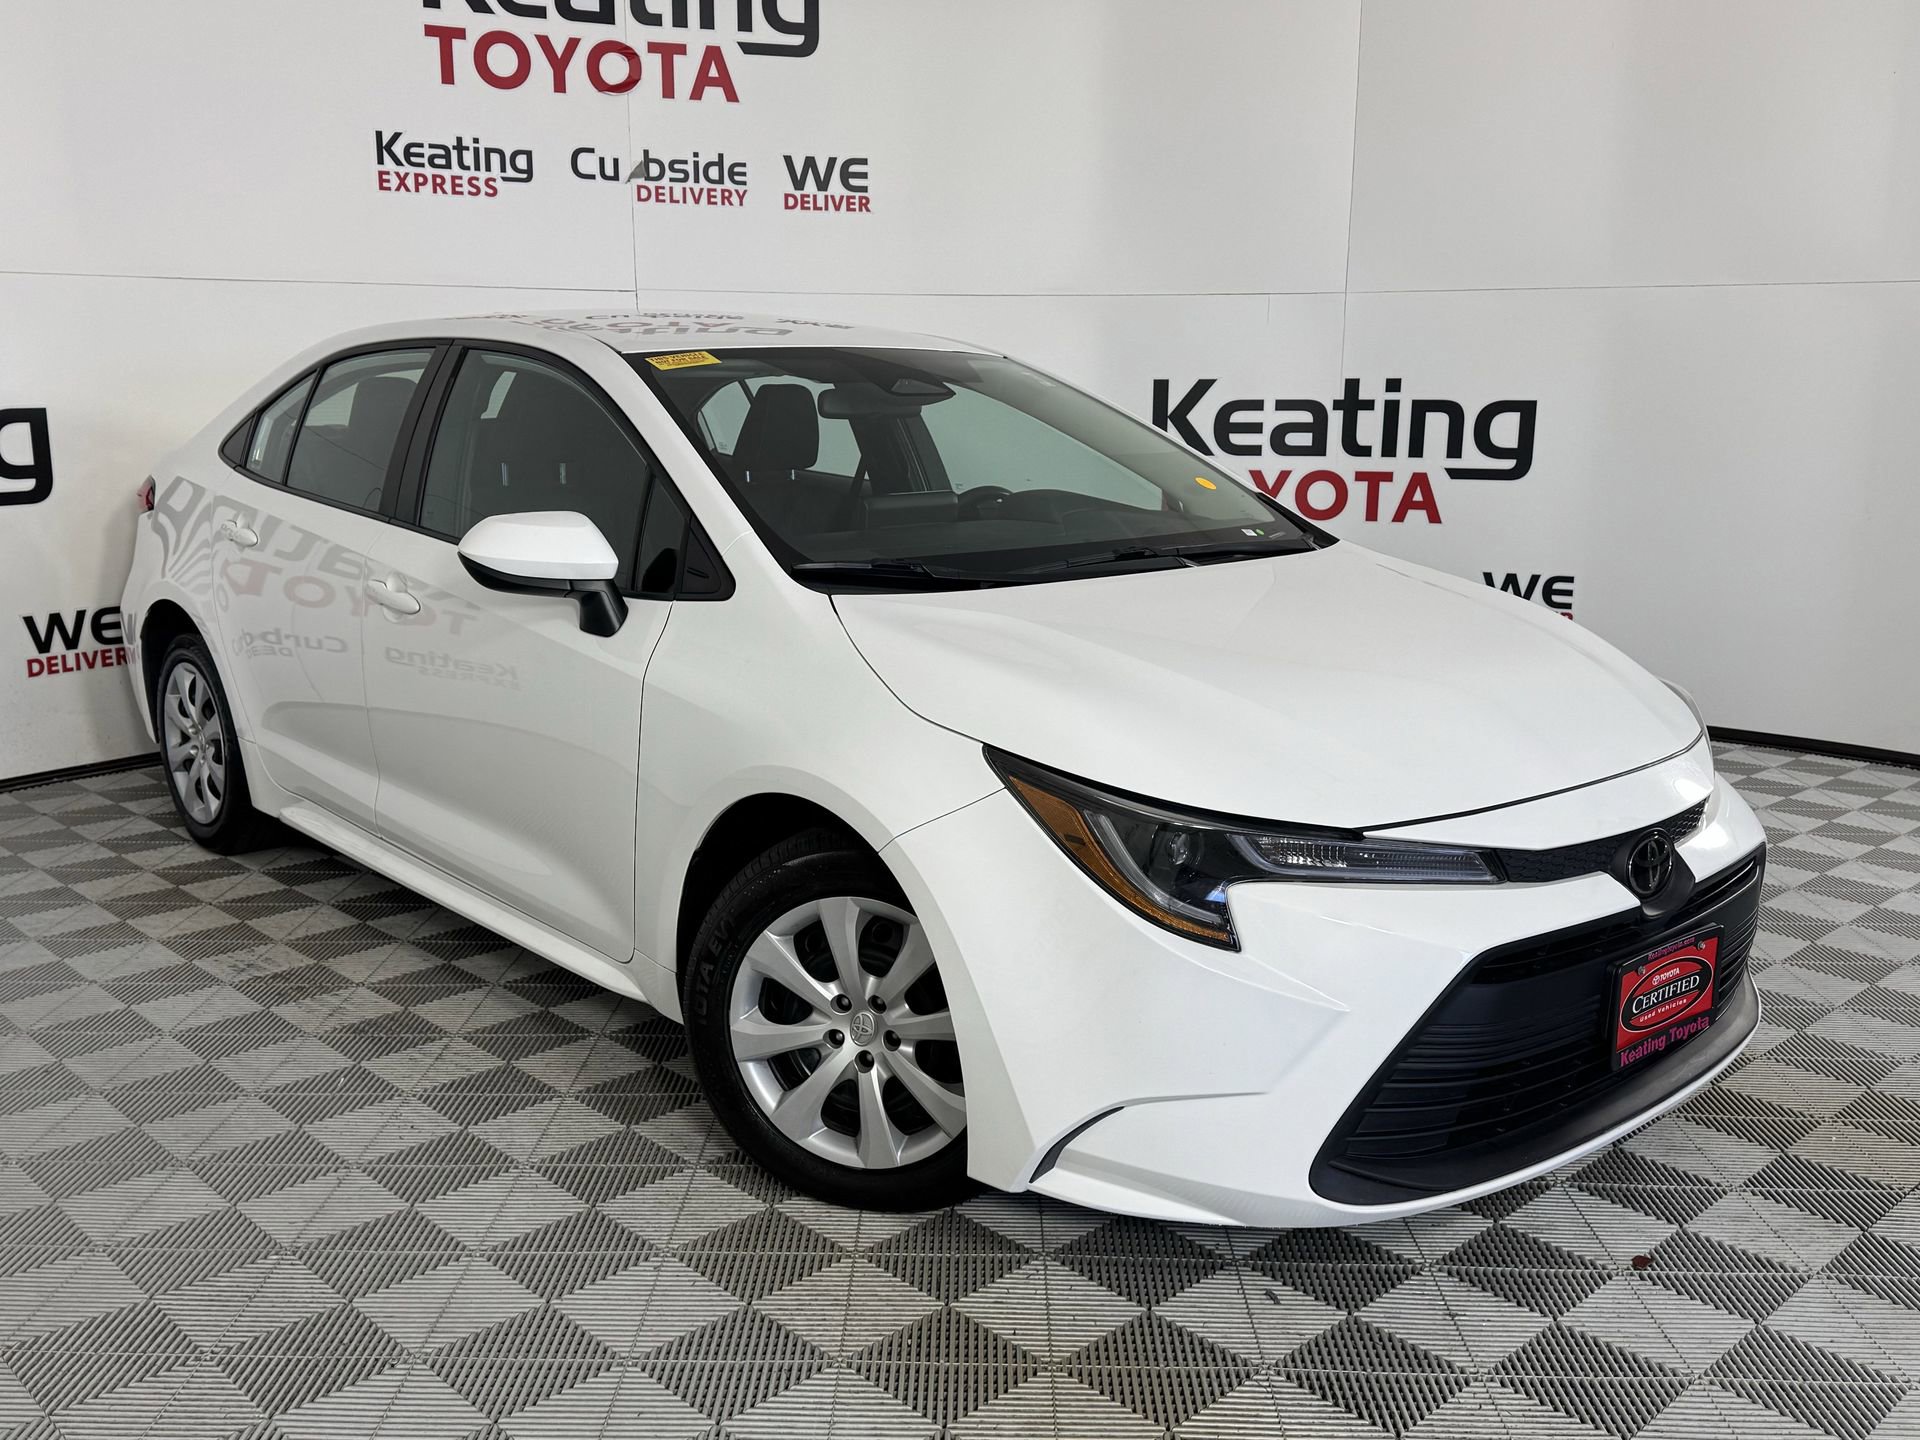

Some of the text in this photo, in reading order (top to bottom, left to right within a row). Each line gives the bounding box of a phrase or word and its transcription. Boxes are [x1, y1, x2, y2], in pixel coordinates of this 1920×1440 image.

[424, 24, 741, 103] TOYOTA
[374, 130, 534, 183] Keating
[570, 147, 748, 187] Cubside
[783, 155, 869, 193] WE
[377, 171, 499, 197] EXPRESS
[636, 185, 748, 207] DELIVERY
[783, 193, 871, 213] DELIVER
[1152, 378, 1538, 480] Keating
[1248, 469, 1442, 524] YOTA
[1482, 572, 1574, 610] WE
[22, 606, 124, 654] WE
[27, 647, 127, 678] DELIVER
[1660, 967, 1680, 981] TOYOTA
[1632, 975, 1700, 1014] CERTIFIED
[1640, 998, 1687, 1022] Used Vehicles
[1620, 1016, 1710, 1067] Keating Toyota
